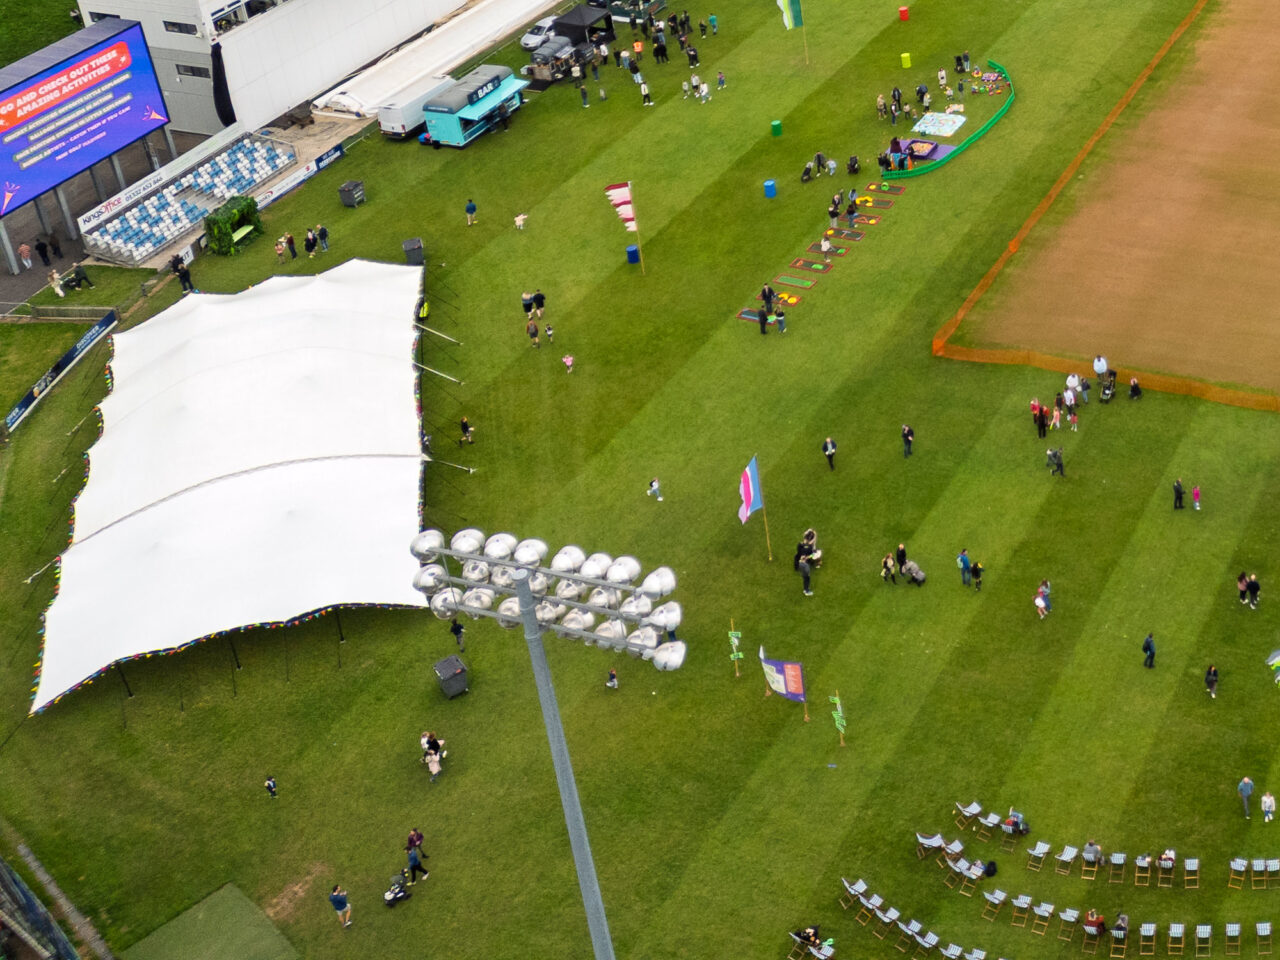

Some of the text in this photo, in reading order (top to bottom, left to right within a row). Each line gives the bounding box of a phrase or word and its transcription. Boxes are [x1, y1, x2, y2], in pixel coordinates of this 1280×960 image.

[0, 49, 118, 115] GO AND CHECK OUT THESE
[16, 64, 111, 118] AMAZING ACTIVITIES
[477, 82, 494, 98] BAR
